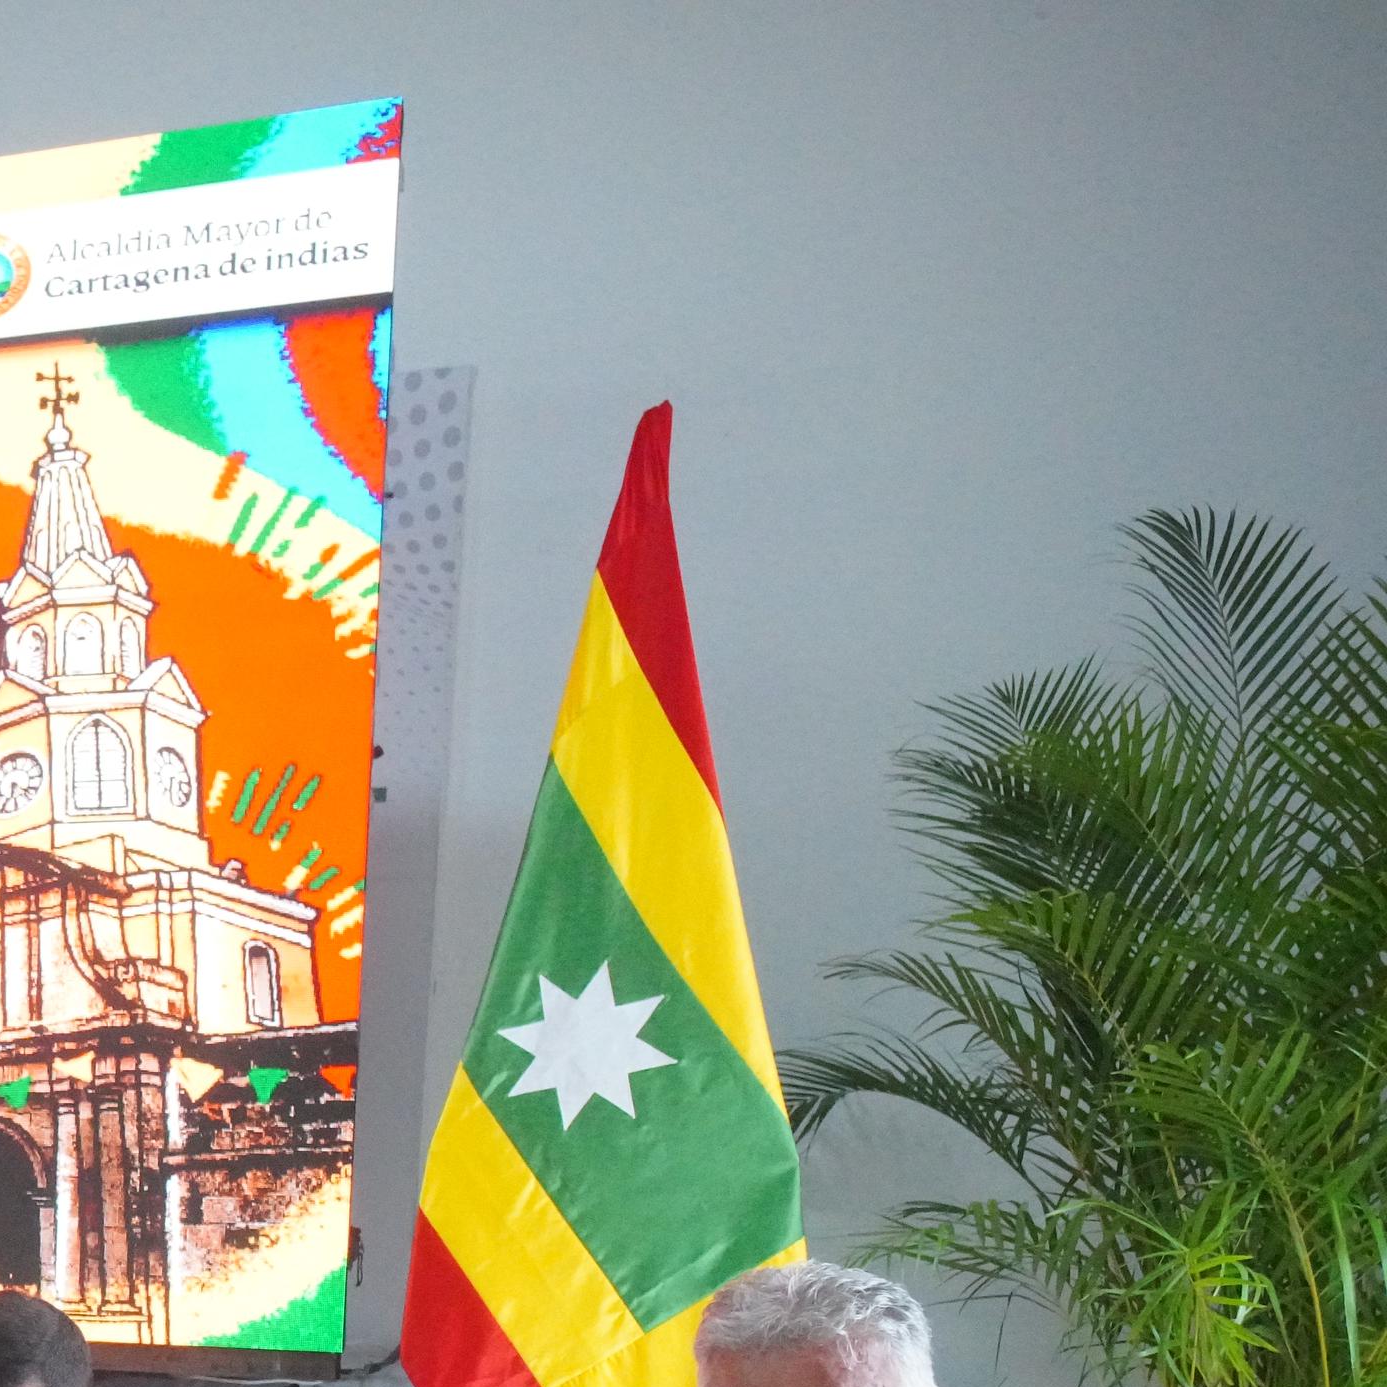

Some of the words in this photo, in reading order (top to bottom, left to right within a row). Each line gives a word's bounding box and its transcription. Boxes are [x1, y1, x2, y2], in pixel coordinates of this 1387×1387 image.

[183, 217, 285, 246] Mayor
[45, 263, 211, 298] Cartagena
[219, 252, 257, 277] de
[266, 241, 369, 272] indias
